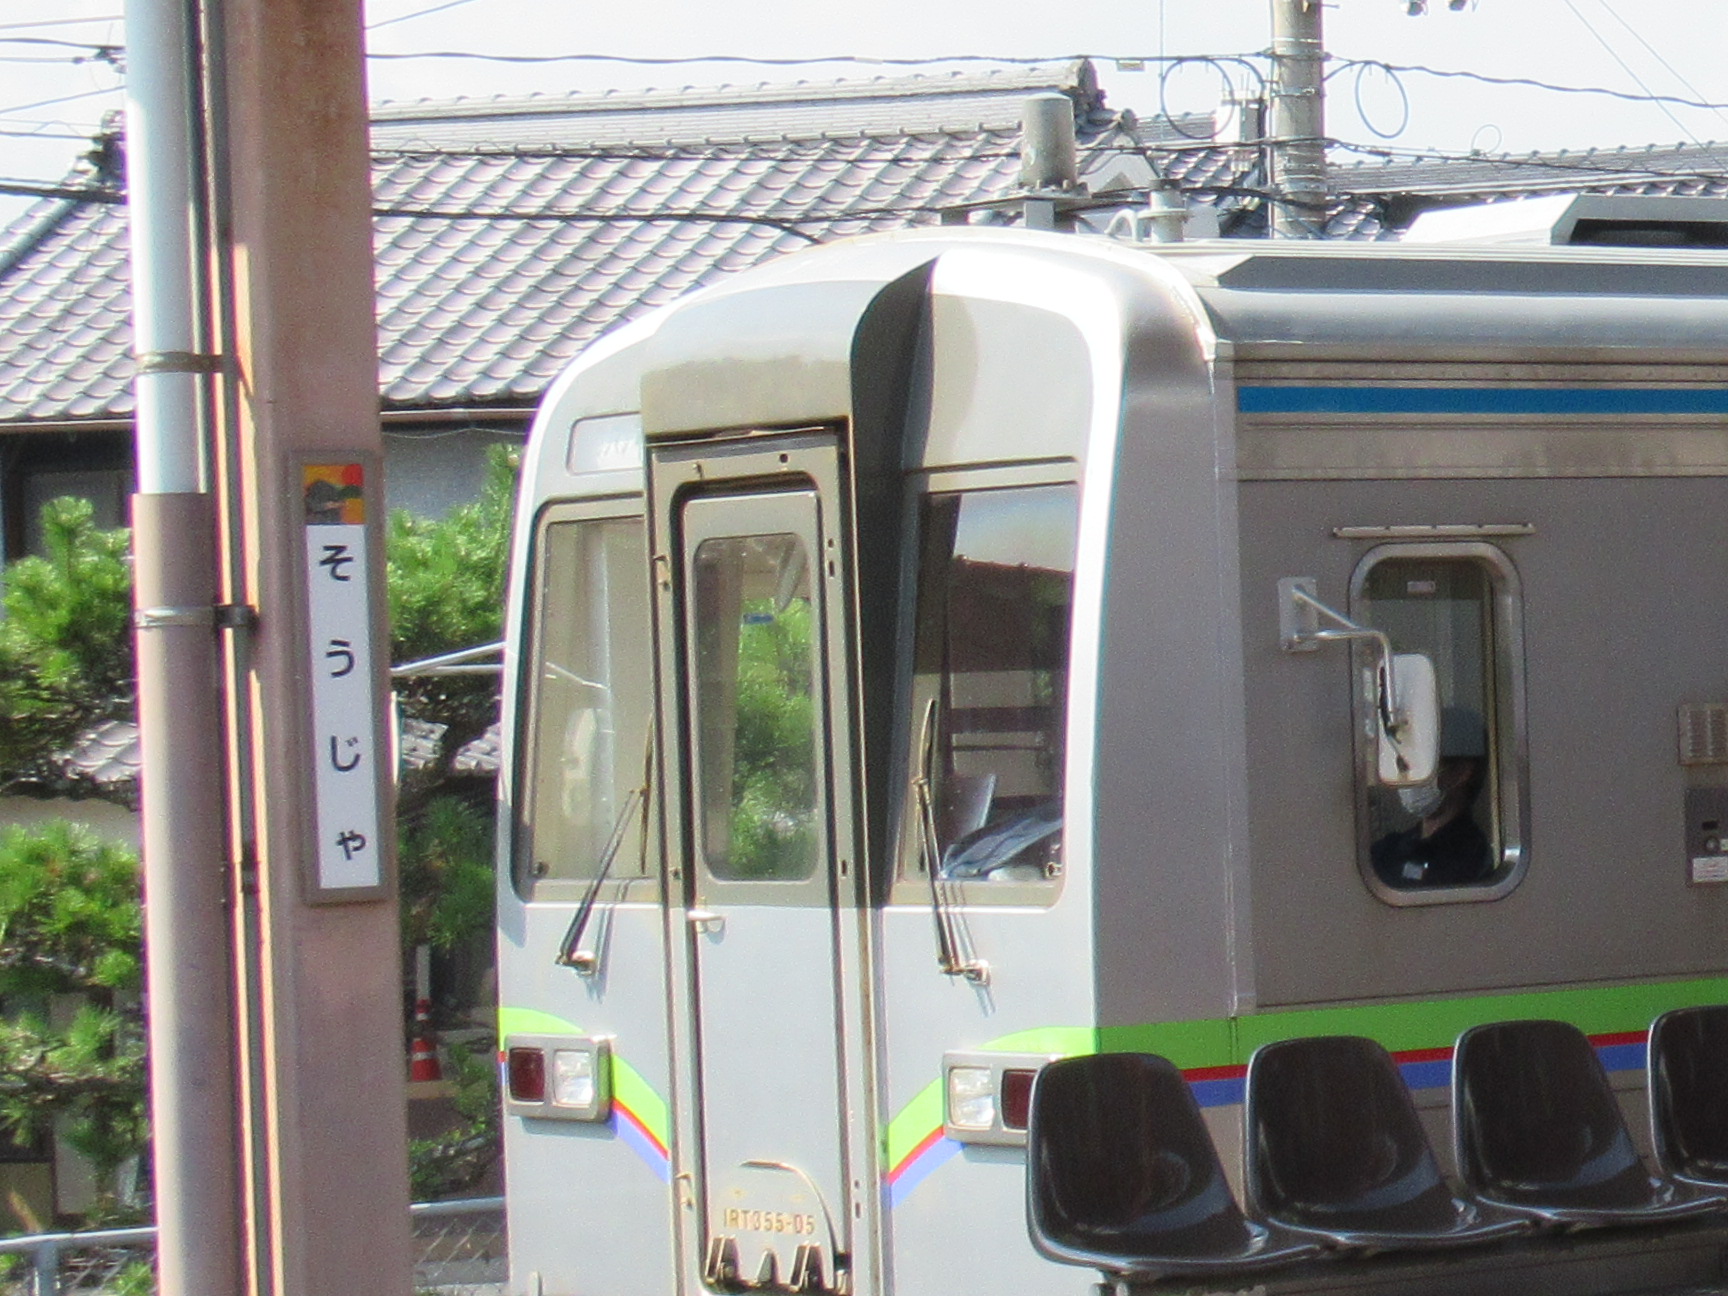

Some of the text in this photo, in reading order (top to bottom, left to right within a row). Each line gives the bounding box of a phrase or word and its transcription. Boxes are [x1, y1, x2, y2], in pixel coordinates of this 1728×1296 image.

[319, 544, 366, 861] そうじや
[723, 1207, 816, 1235] IRT355-05
